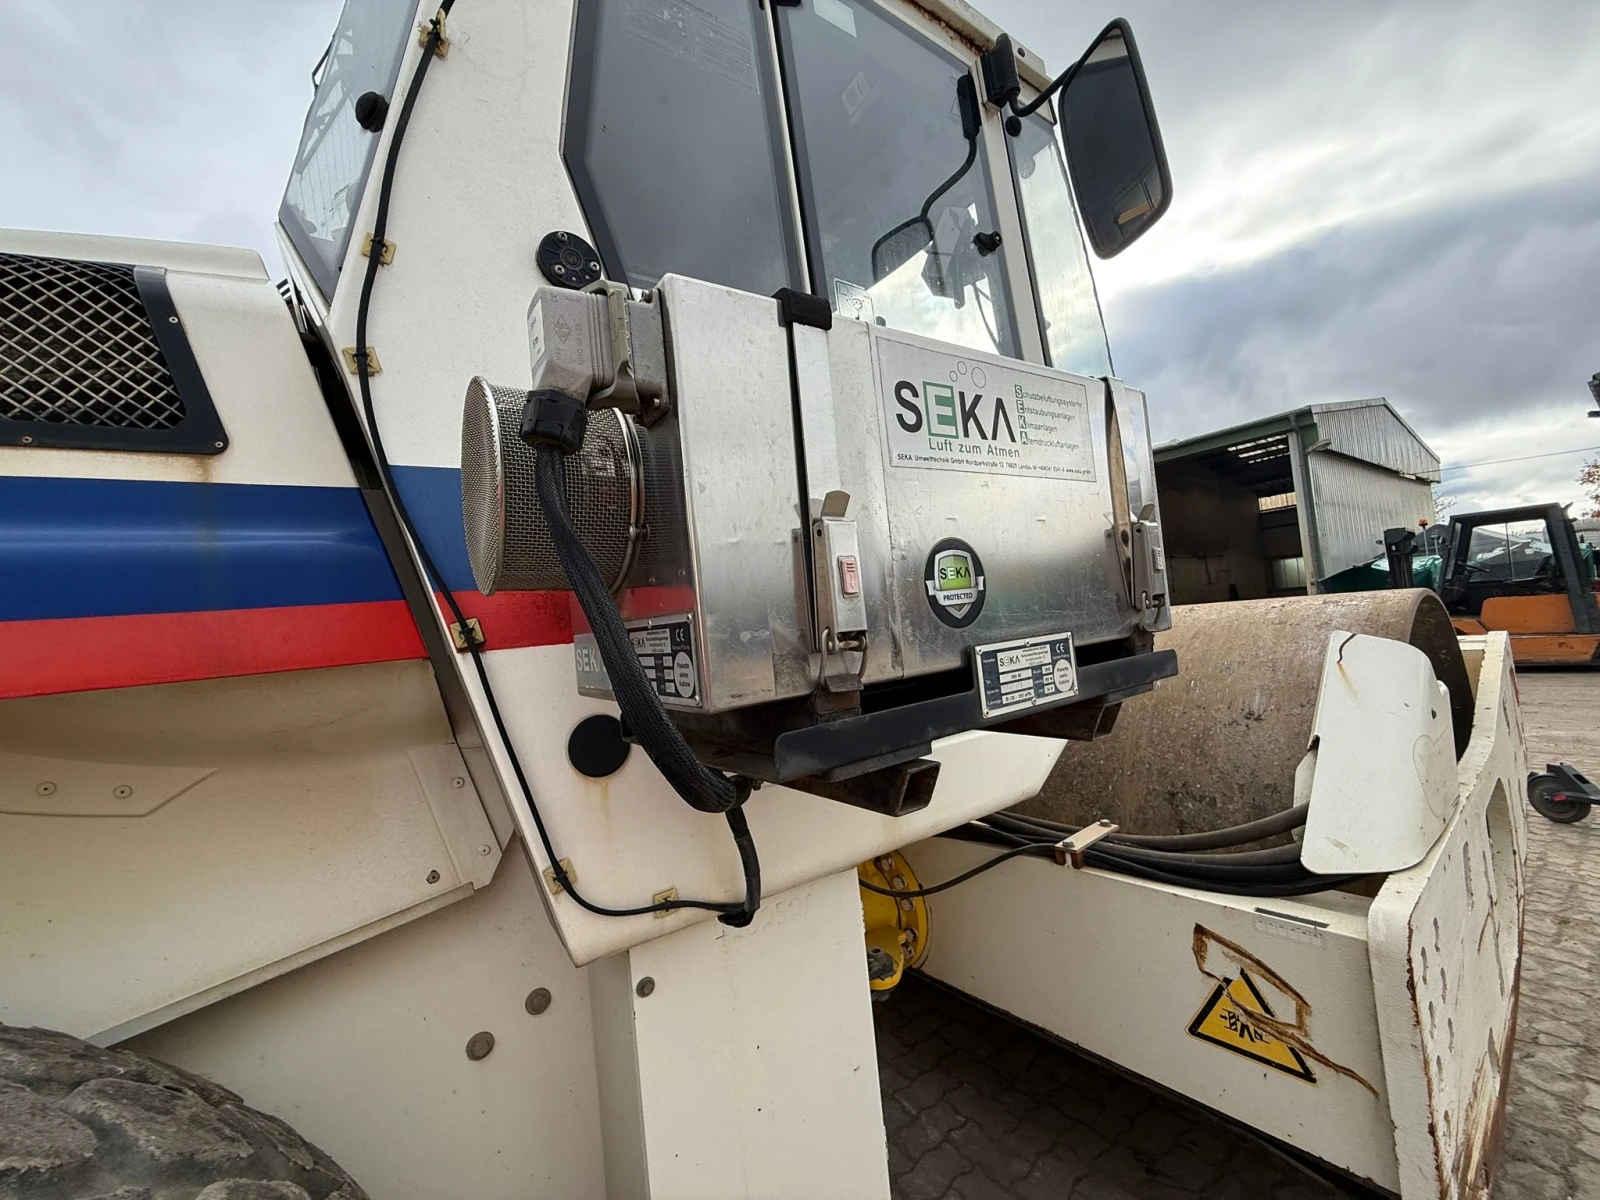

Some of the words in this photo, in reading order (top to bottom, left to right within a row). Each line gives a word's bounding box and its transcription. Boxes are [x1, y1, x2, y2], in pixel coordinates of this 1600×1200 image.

[894, 379, 1017, 443] SEKA
[1016, 399, 1076, 422] Entstaubungsanlagen
[1018, 415, 1058, 434] Klimaanlagen
[928, 437, 953, 452] Luft
[958, 443, 982, 455] zum
[987, 445, 1020, 458] Atmen
[1020, 430, 1080, 451] Atemdruckluftanlagen
[897, 453, 913, 461] SEKA
[914, 454, 950, 463] Umwelttechnik
[939, 566, 971, 580] SEKA
[943, 592, 973, 602] PROTECTED
[999, 655, 1021, 667] SEKA
